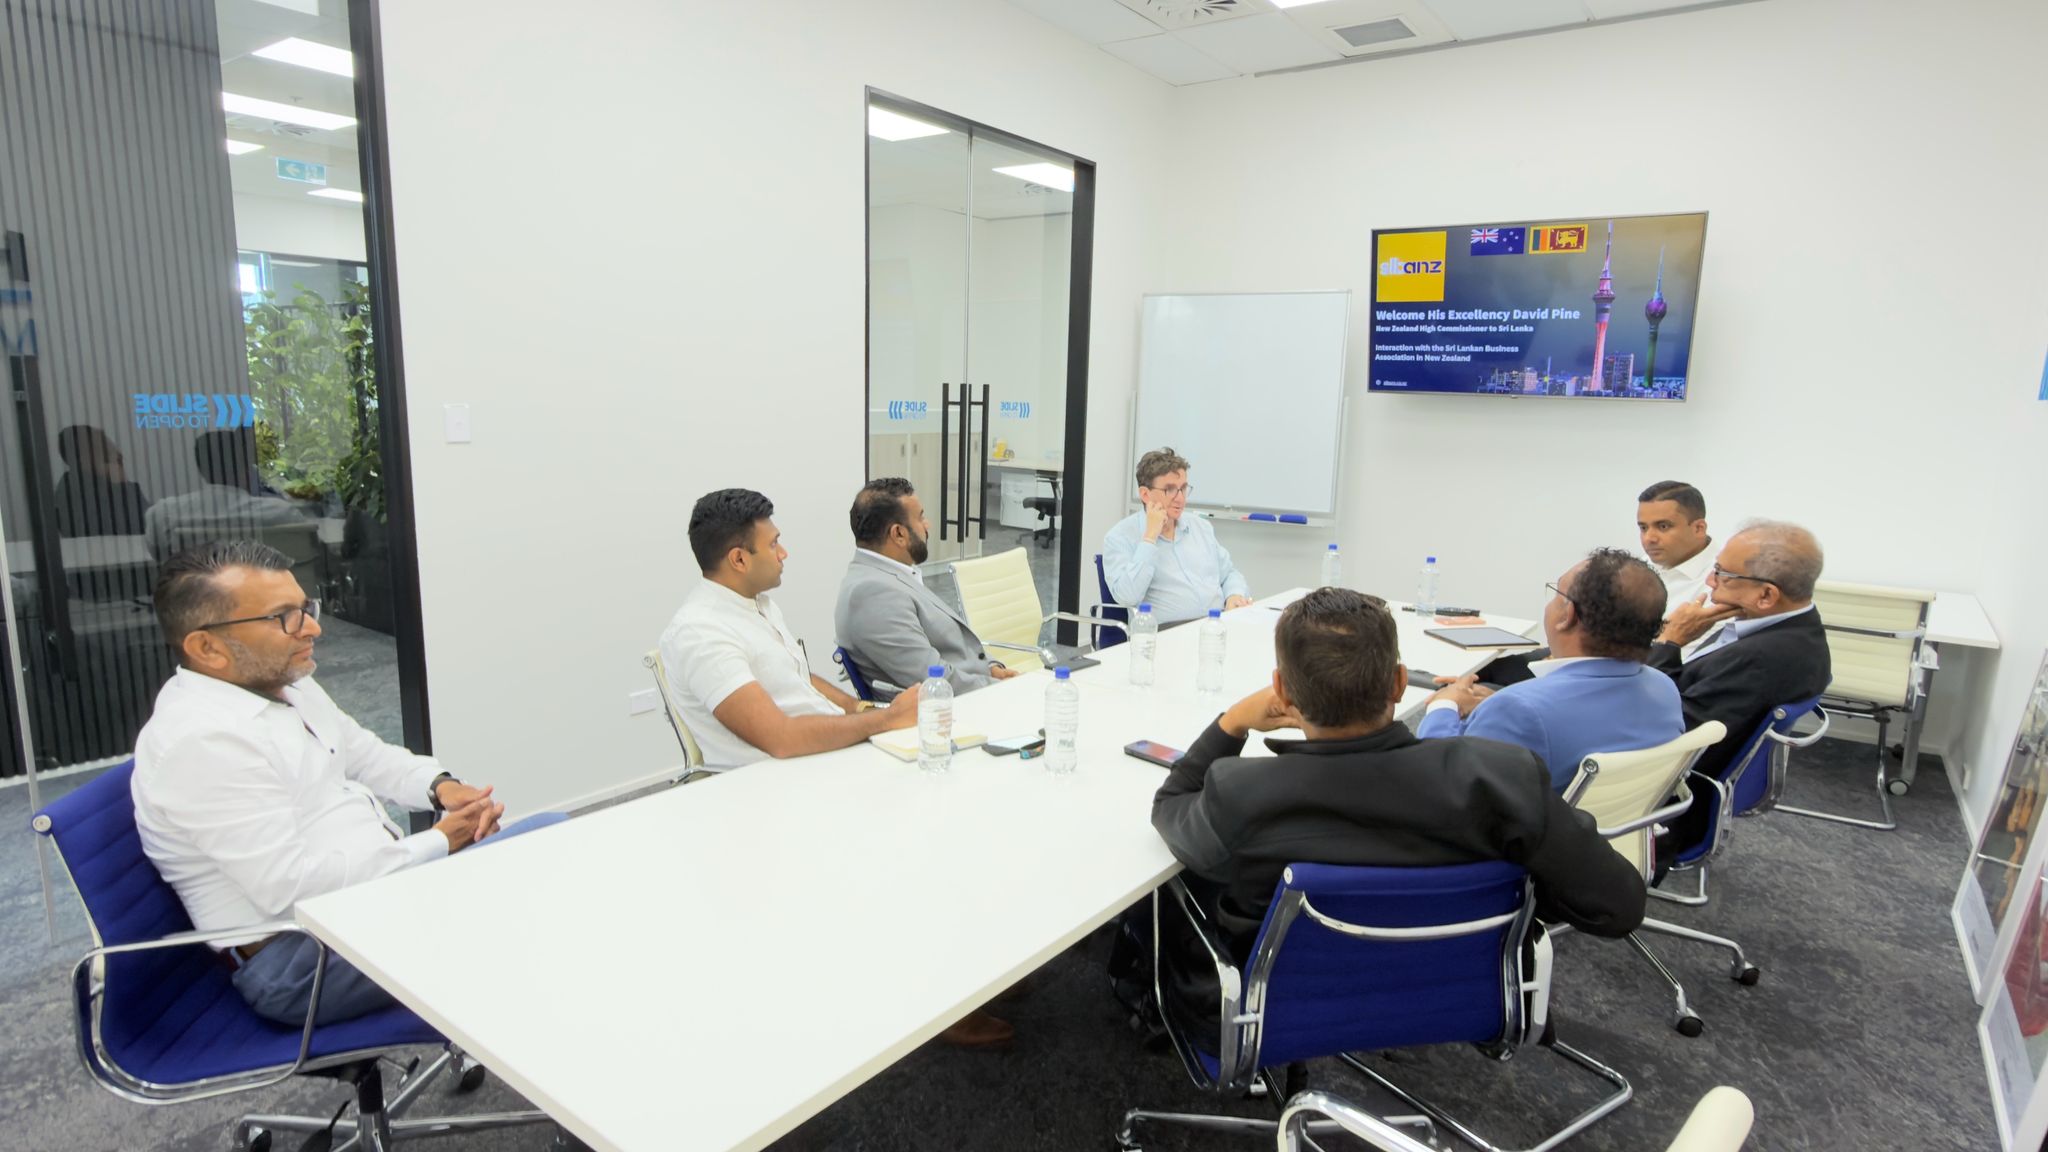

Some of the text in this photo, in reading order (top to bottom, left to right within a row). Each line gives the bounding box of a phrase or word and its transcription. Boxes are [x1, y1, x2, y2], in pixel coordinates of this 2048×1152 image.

[1376, 308, 1580, 322] Welcome His Excellency David Pine
[1419, 325, 1436, 333] High
[1457, 344, 1484, 352] Lankan
[1441, 354, 1471, 362] Zealand
